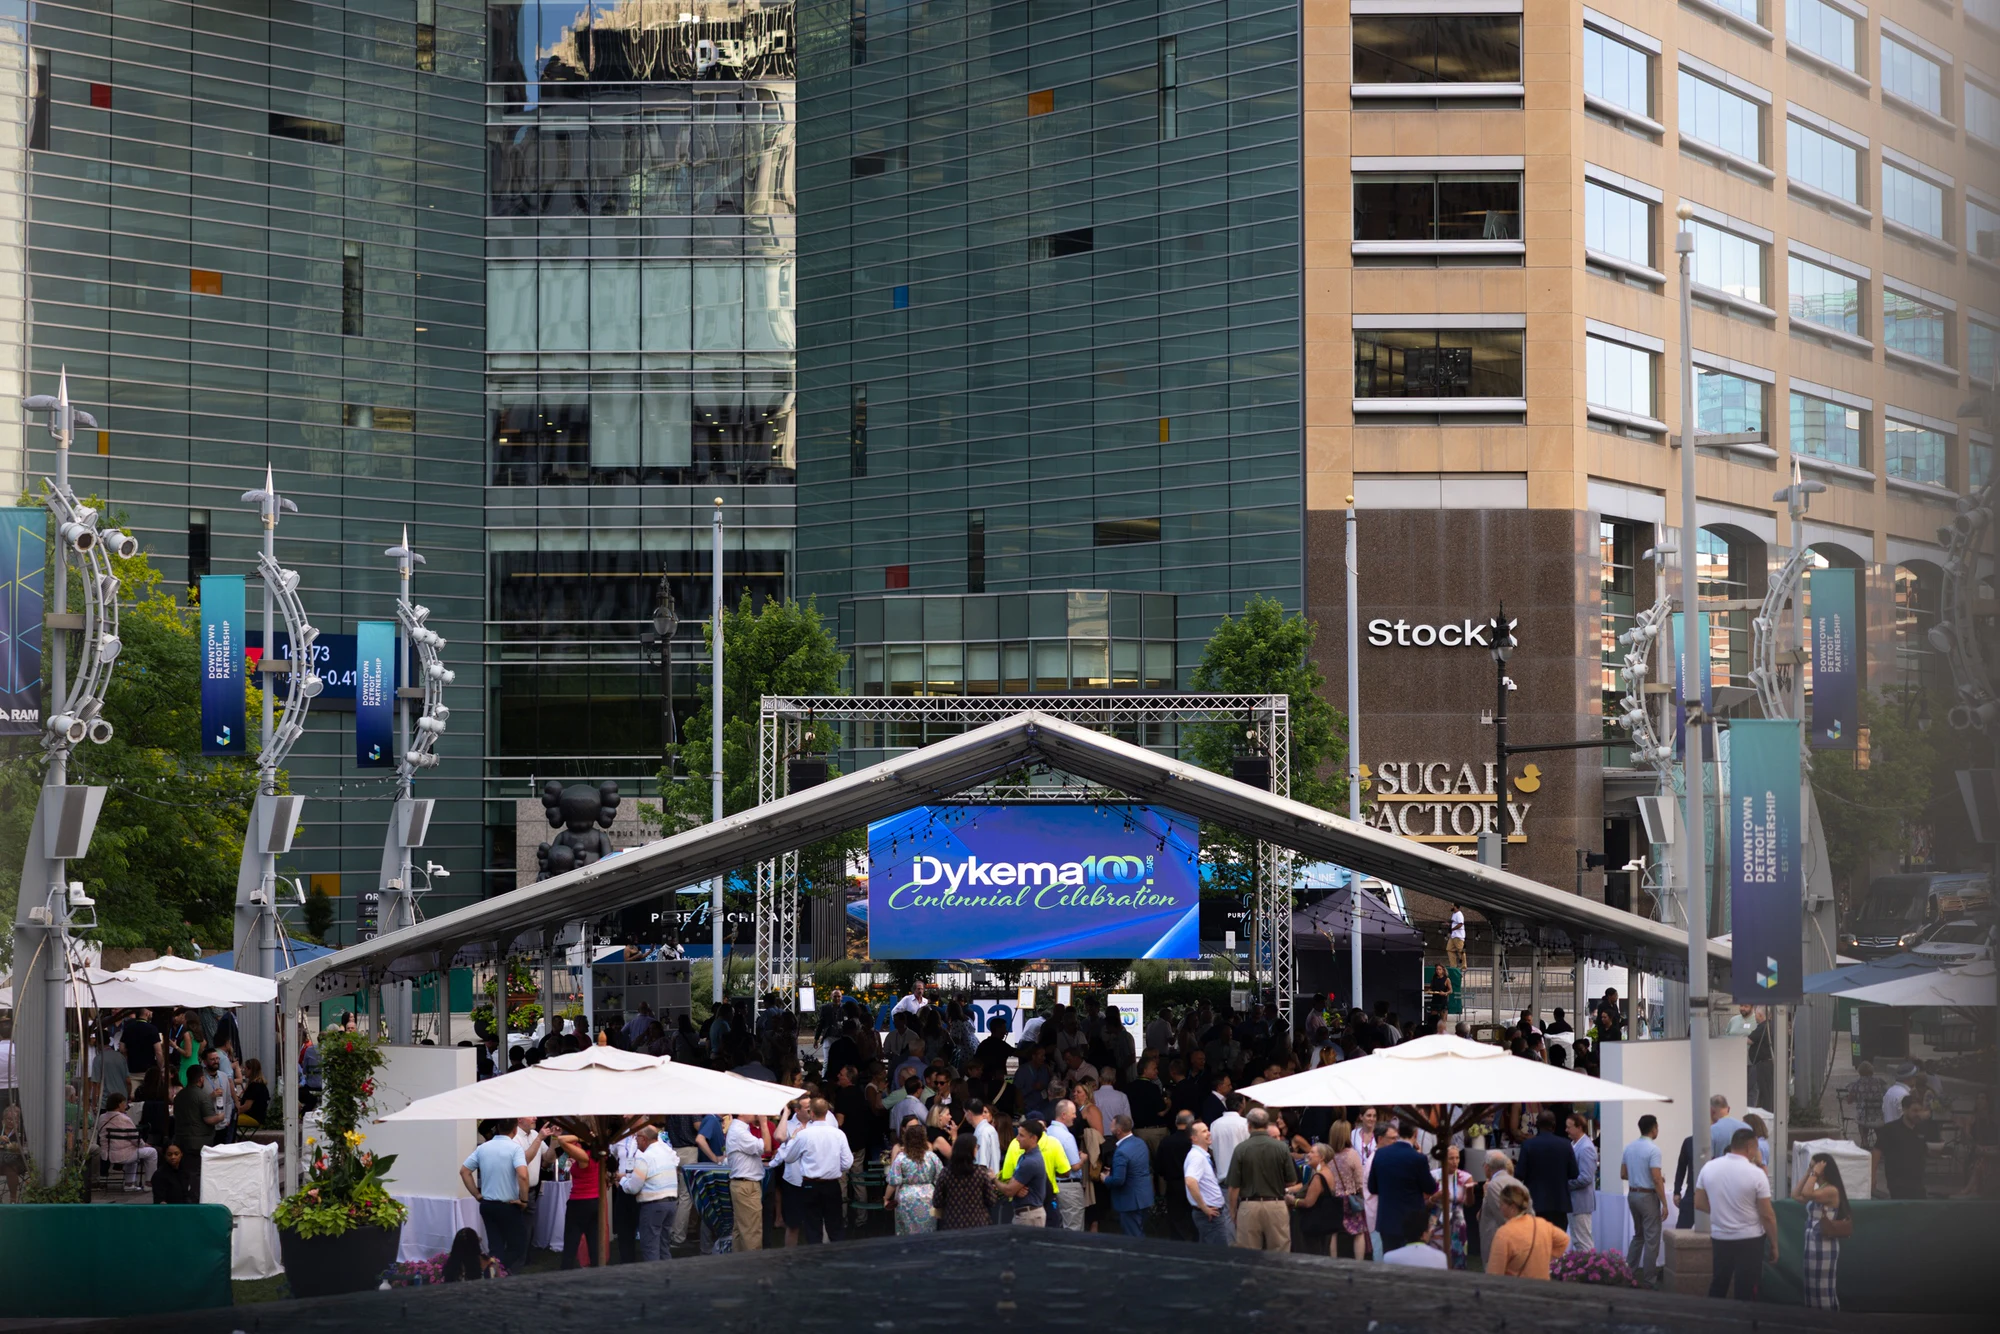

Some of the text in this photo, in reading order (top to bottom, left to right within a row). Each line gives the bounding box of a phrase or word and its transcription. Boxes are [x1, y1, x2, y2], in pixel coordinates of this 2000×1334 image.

[1819, 617, 1827, 672] DOWNTOWN
[11, 709, 39, 720] RAM
[1743, 796, 1754, 883] DOWNTOWN
[1755, 824, 1765, 883] DETROIT
[1766, 790, 1777, 883] PARTNERSHIP
[888, 880, 1180, 910] Centennial Celebration
[913, 856, 1084, 893] Dykema
[1080, 855, 1146, 885] 100
[651, 912, 692, 923] PRE
